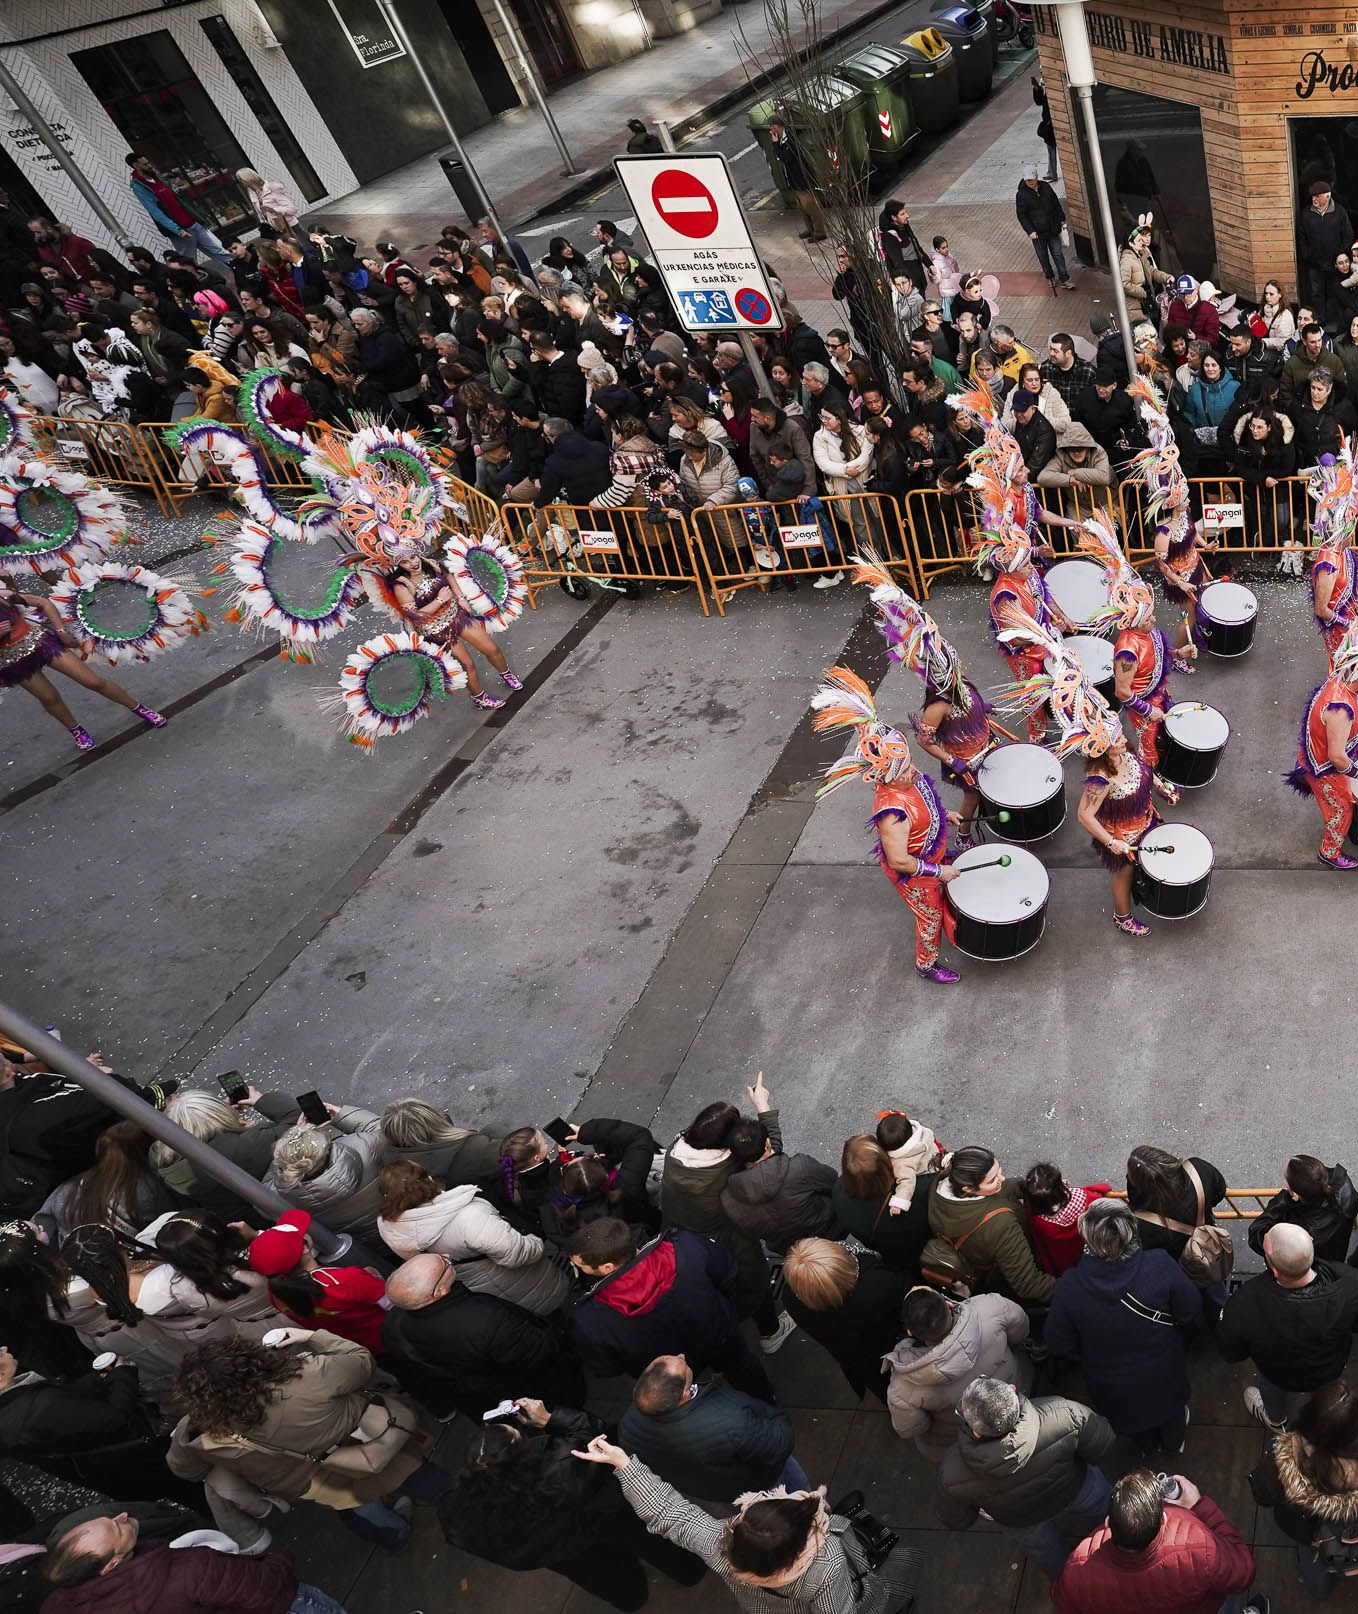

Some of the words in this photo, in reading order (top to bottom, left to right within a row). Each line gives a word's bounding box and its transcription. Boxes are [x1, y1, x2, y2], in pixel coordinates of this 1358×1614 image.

[353, 34, 369, 45] Sra.
[360, 39, 395, 57] Florinda
[1130, 20, 1155, 58] DE
[1160, 24, 1230, 74] AMELIA
[8, 123, 66, 139] CONSTA
[16, 133, 73, 149] DIETCA
[693, 251, 718, 259] AGÁS
[663, 263, 715, 271] URXENCIAS
[716, 261, 757, 270] MÉDICAS
[693, 276, 700, 284] E
[701, 275, 738, 284] GARAXE
